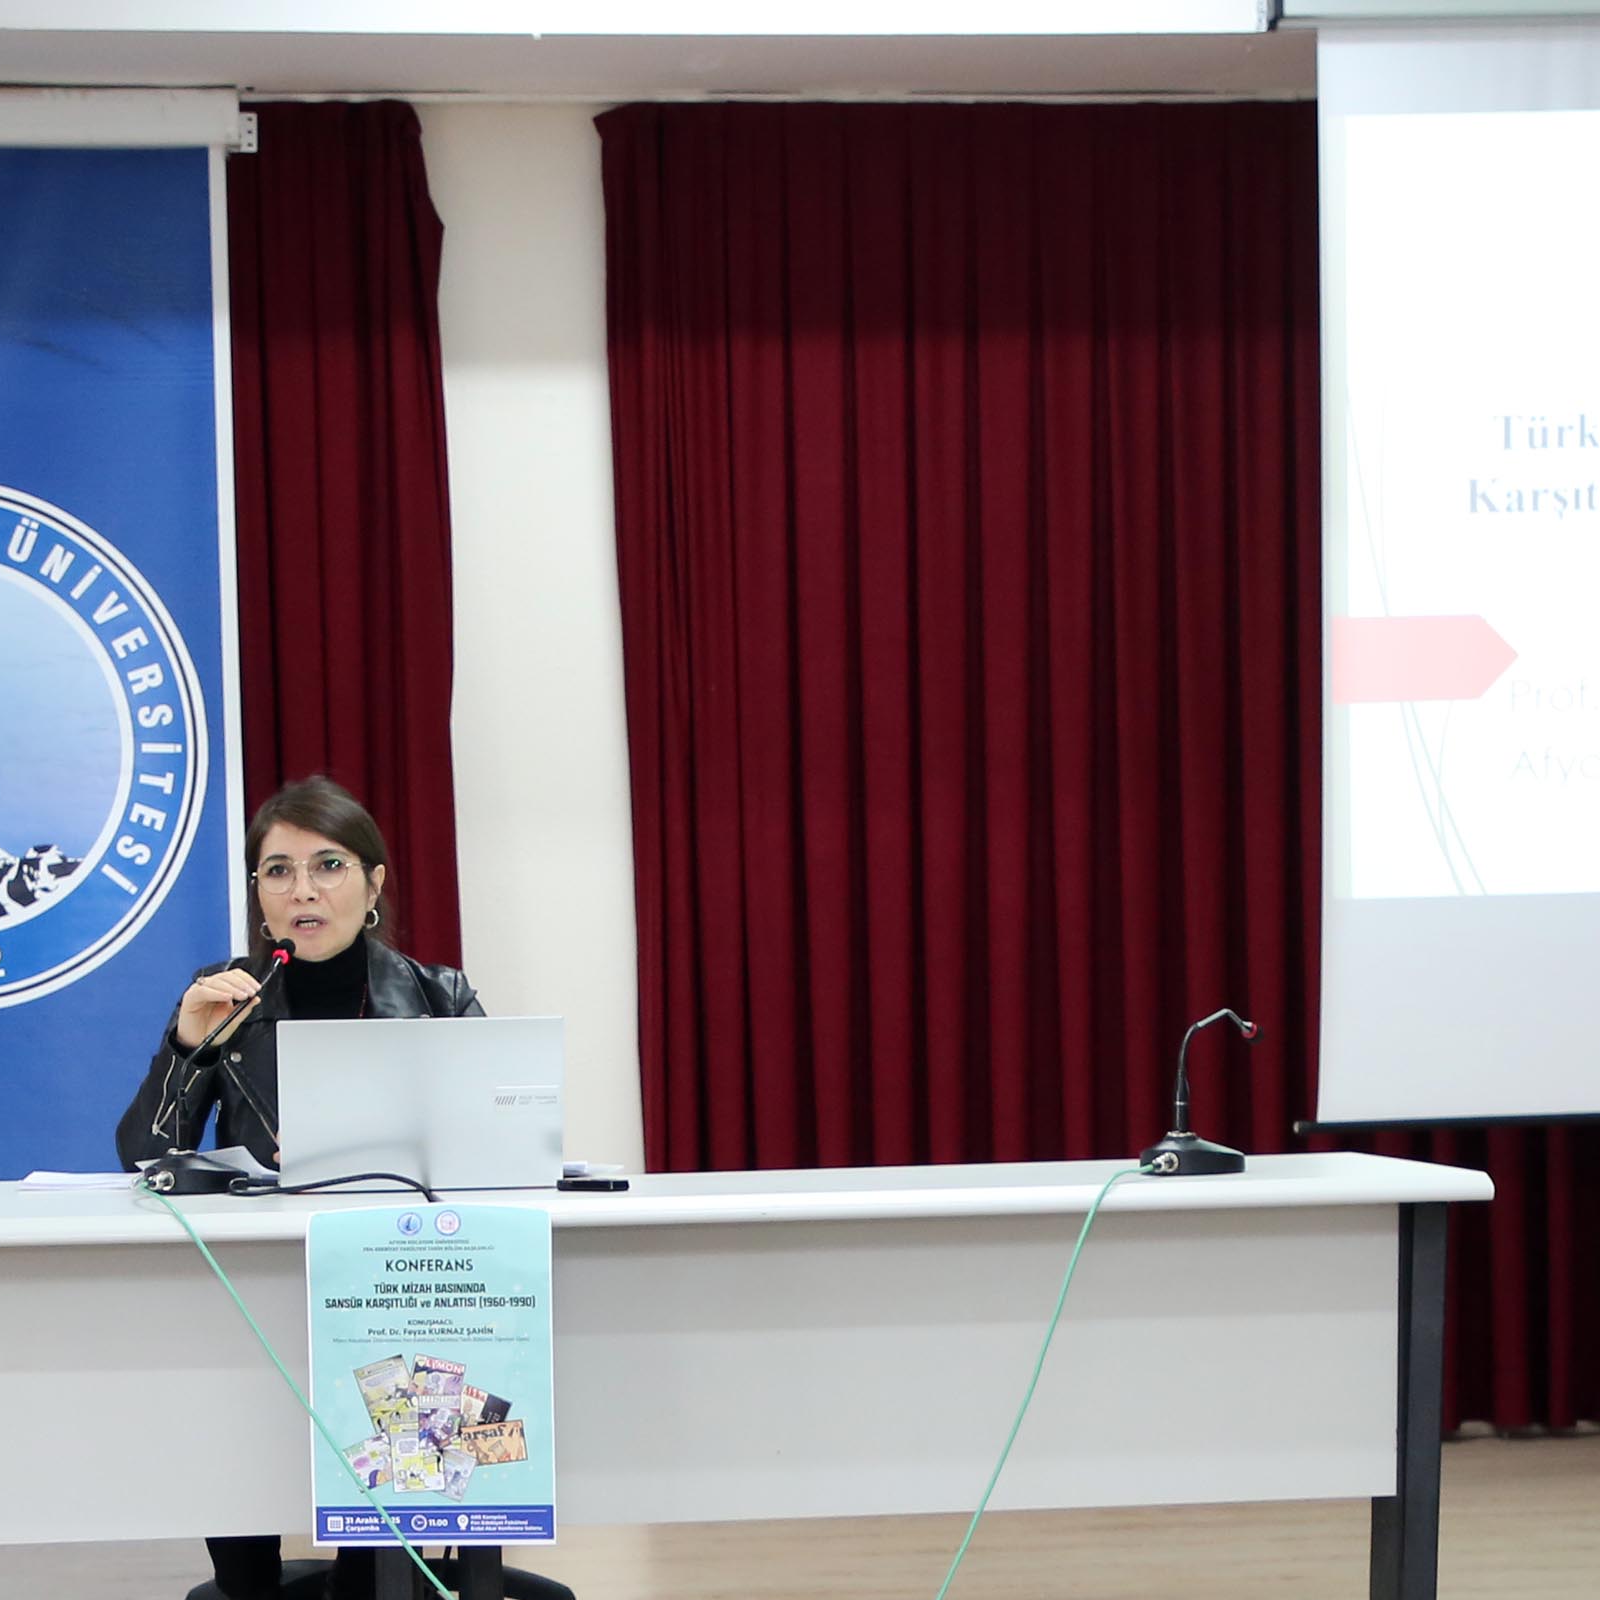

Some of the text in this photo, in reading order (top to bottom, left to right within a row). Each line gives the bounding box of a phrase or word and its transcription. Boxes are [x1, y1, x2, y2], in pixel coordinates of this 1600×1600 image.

[1493, 413, 1600, 451] Türk
[1510, 677, 1599, 712] Prof.
[7, 518, 183, 896] ÜNİVERSİTESİ
[385, 1258, 474, 1273] KONFERANS
[374, 1281, 486, 1294] TÜRK MİZAH BASININDA
[325, 1297, 363, 1309] SANSÜR
[365, 1296, 418, 1311] KARŞITLIĞI
[420, 1300, 432, 1309] ve
[434, 1296, 477, 1308] ANLATISI
[368, 1328, 387, 1336] Prof.
[389, 1328, 401, 1336] Dr.
[428, 1327, 464, 1335] KURNAZ
[466, 1326, 494, 1337] ŞAHİN
[355, 1516, 379, 1524] Aralık
[381, 1516, 400, 1524] 225
[428, 1518, 449, 1527] 11.00
